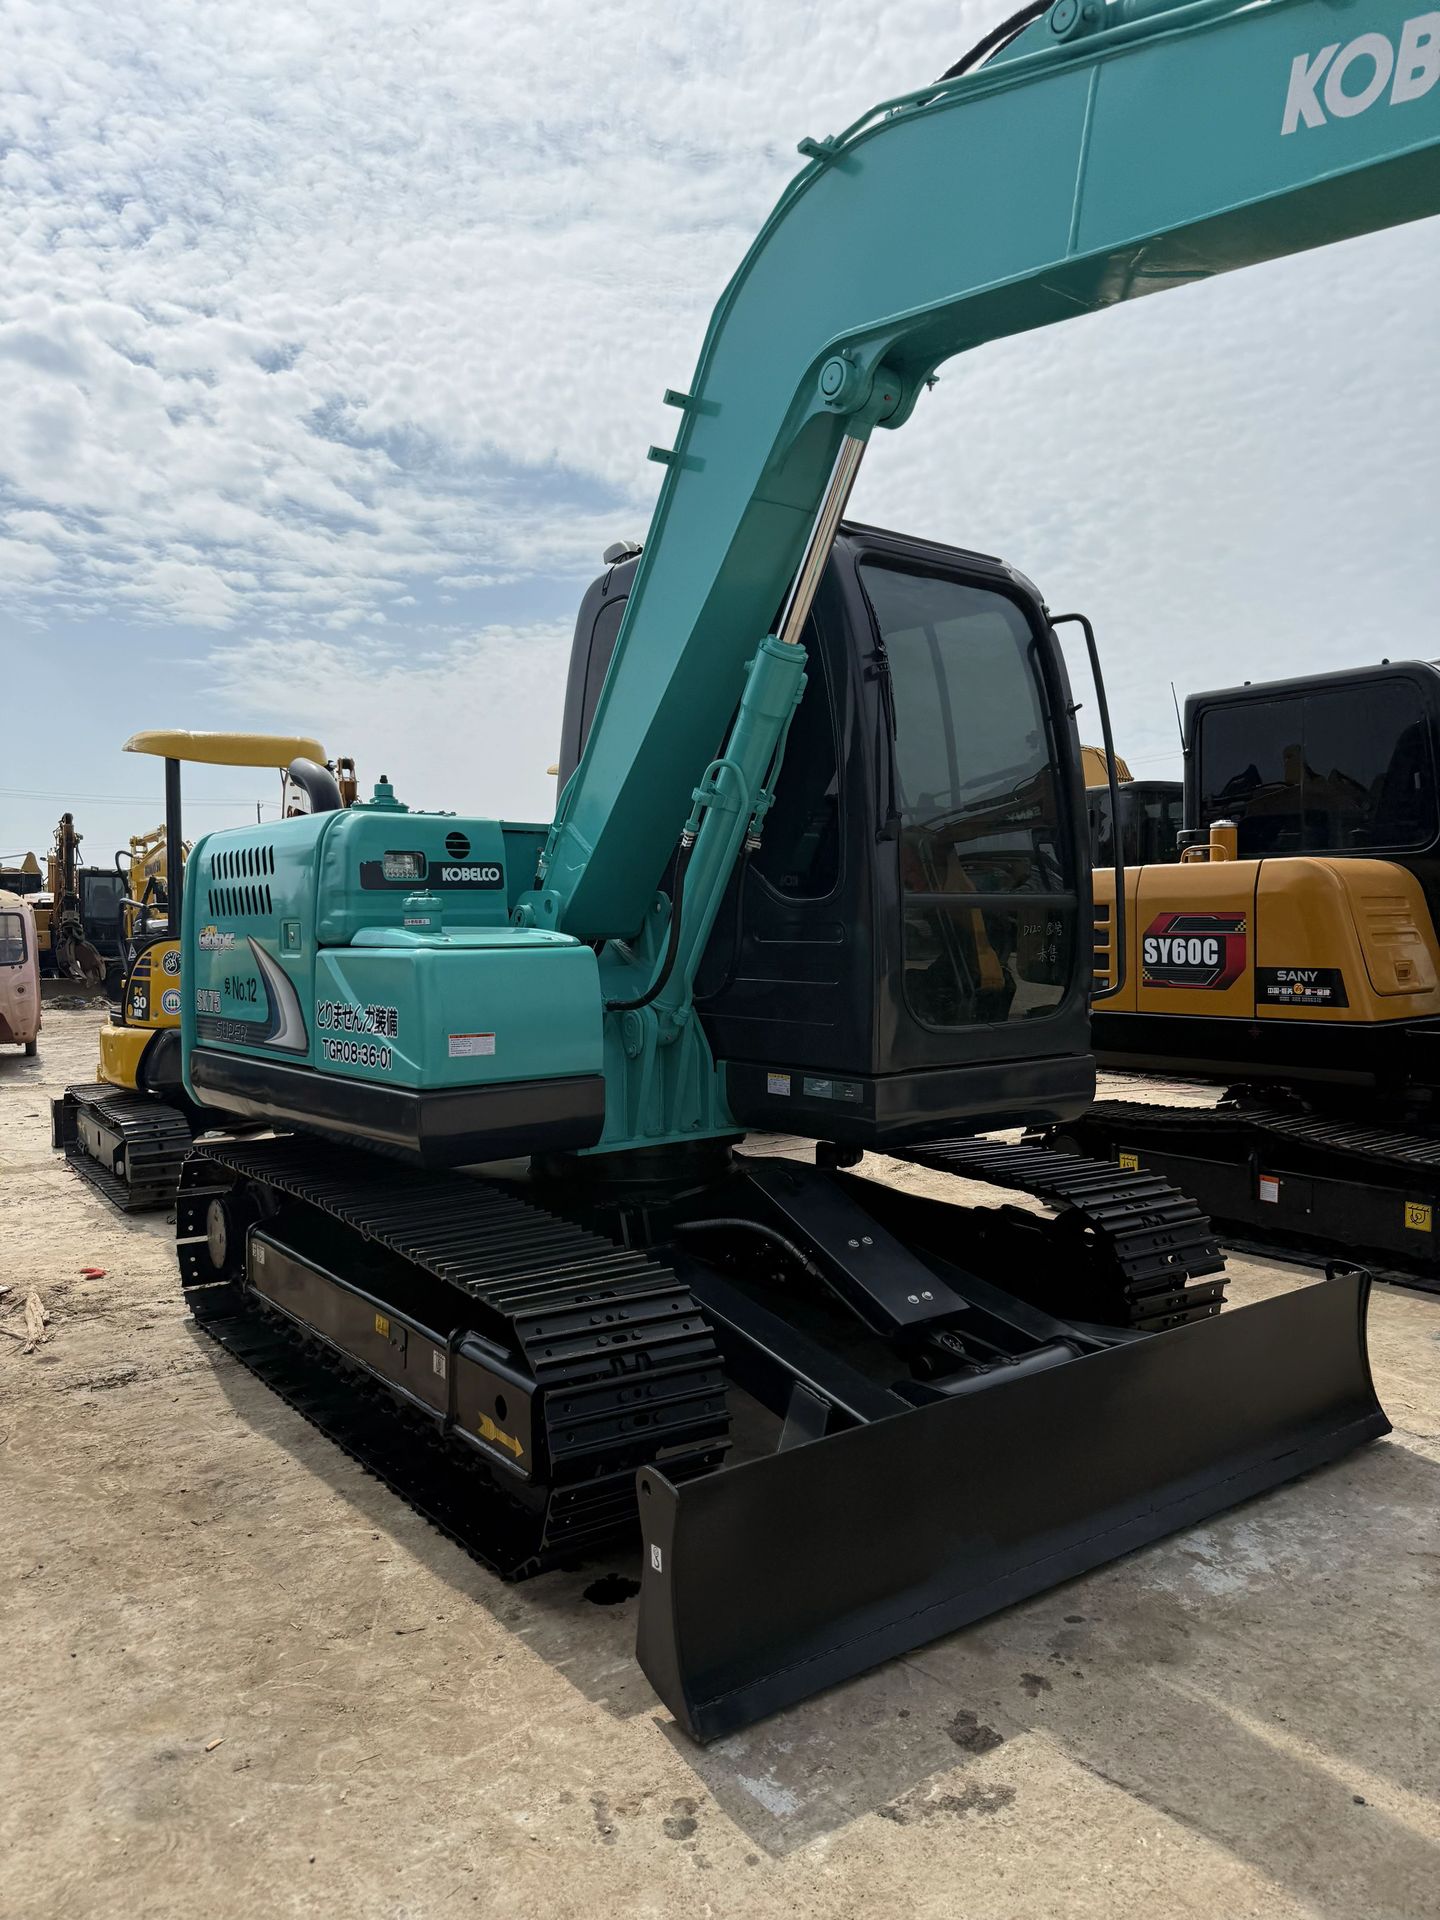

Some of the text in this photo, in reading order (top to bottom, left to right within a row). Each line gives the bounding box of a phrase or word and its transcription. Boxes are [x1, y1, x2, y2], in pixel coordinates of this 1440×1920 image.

[1280, 11, 1440, 136] KOB
[441, 867, 500, 882] KOBELCO
[1144, 938, 1219, 966] SY60C
[1276, 970, 1319, 982] SANY
[232, 975, 257, 1003] No.12
[133, 995, 147, 1009] 30
[216, 1020, 249, 1043] SUPER
[322, 1037, 393, 1071] TGR08-36-01
